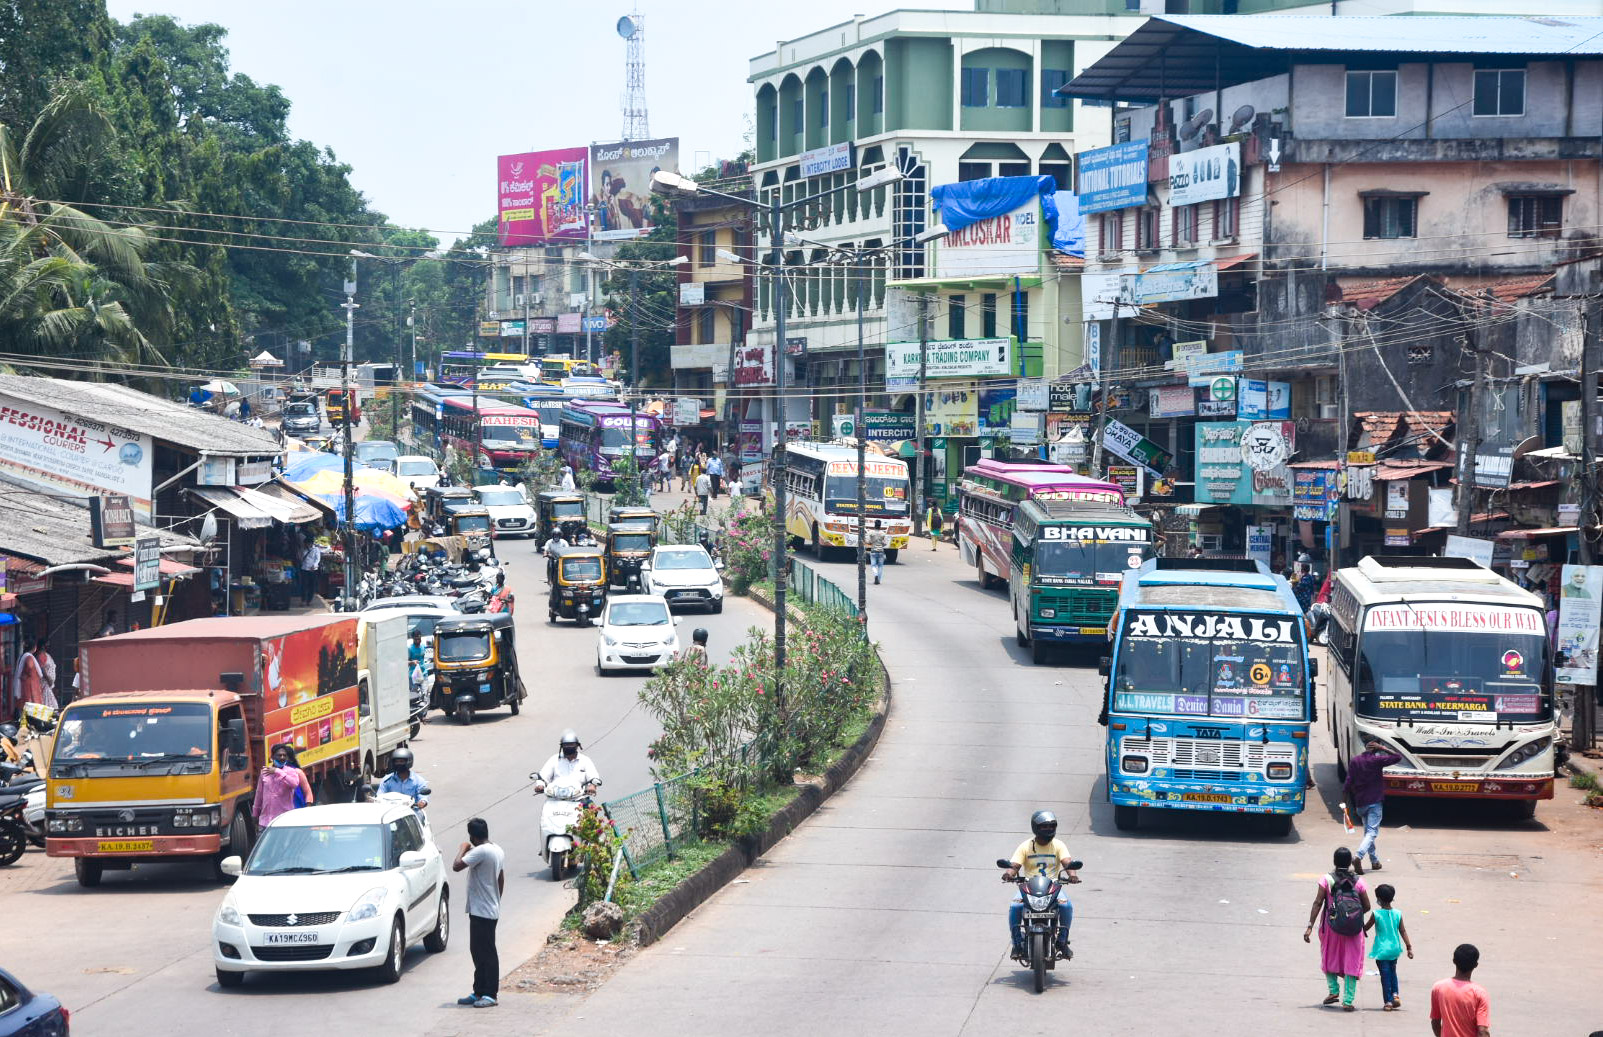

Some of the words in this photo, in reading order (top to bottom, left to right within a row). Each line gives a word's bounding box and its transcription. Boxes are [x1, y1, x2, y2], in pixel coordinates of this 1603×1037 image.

[932, 351, 958, 364] TRADING
[960, 349, 990, 362] COMPANY
[483, 417, 538, 427] MAHESH
[868, 429, 914, 437] INTERCITY
[1105, 427, 1133, 450] OKAYA
[43, 435, 86, 454] COURIERS
[1044, 528, 1146, 541] BHAVANI
[1372, 610, 1411, 627] INFANT
[1412, 611, 1448, 627] JESUS
[1450, 611, 1487, 628] BLESS
[1489, 613, 1511, 629] OUR
[1516, 613, 1538, 631] WAY
[1129, 614, 1294, 643] ANJALI
[1379, 701, 1404, 709] STATE
[1405, 701, 1427, 709] BANK
[1435, 702, 1487, 711] NEERMARGA
[1196, 729, 1222, 738] TATA
[96, 826, 159, 837] EICHER
